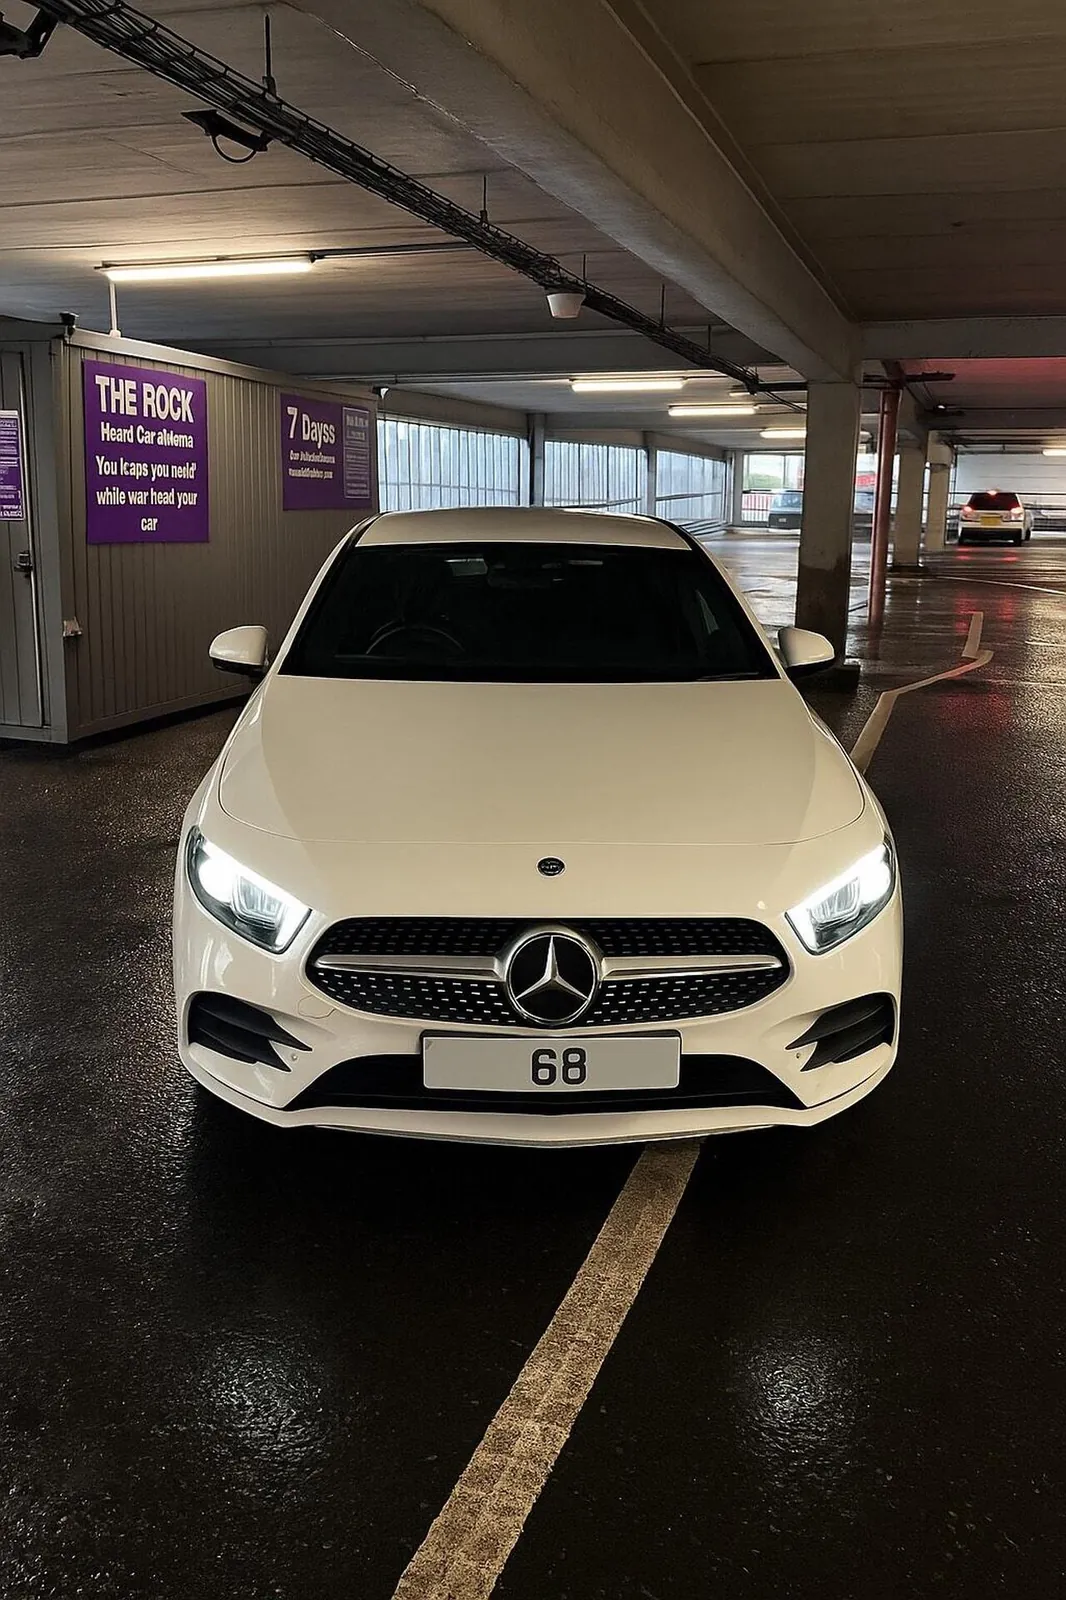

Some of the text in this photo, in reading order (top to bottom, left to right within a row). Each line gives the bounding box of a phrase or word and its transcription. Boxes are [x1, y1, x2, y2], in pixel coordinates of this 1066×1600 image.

[95, 374, 194, 423] THE ROCK
[101, 421, 134, 443] Heard
[136, 425, 156, 445] Car
[287, 406, 298, 439] 7
[302, 413, 336, 449] Dayss
[95, 455, 118, 476] You
[151, 463, 170, 482] you
[96, 487, 198, 509] while war head your
[140, 516, 159, 532] car
[531, 1047, 587, 1086] 68
